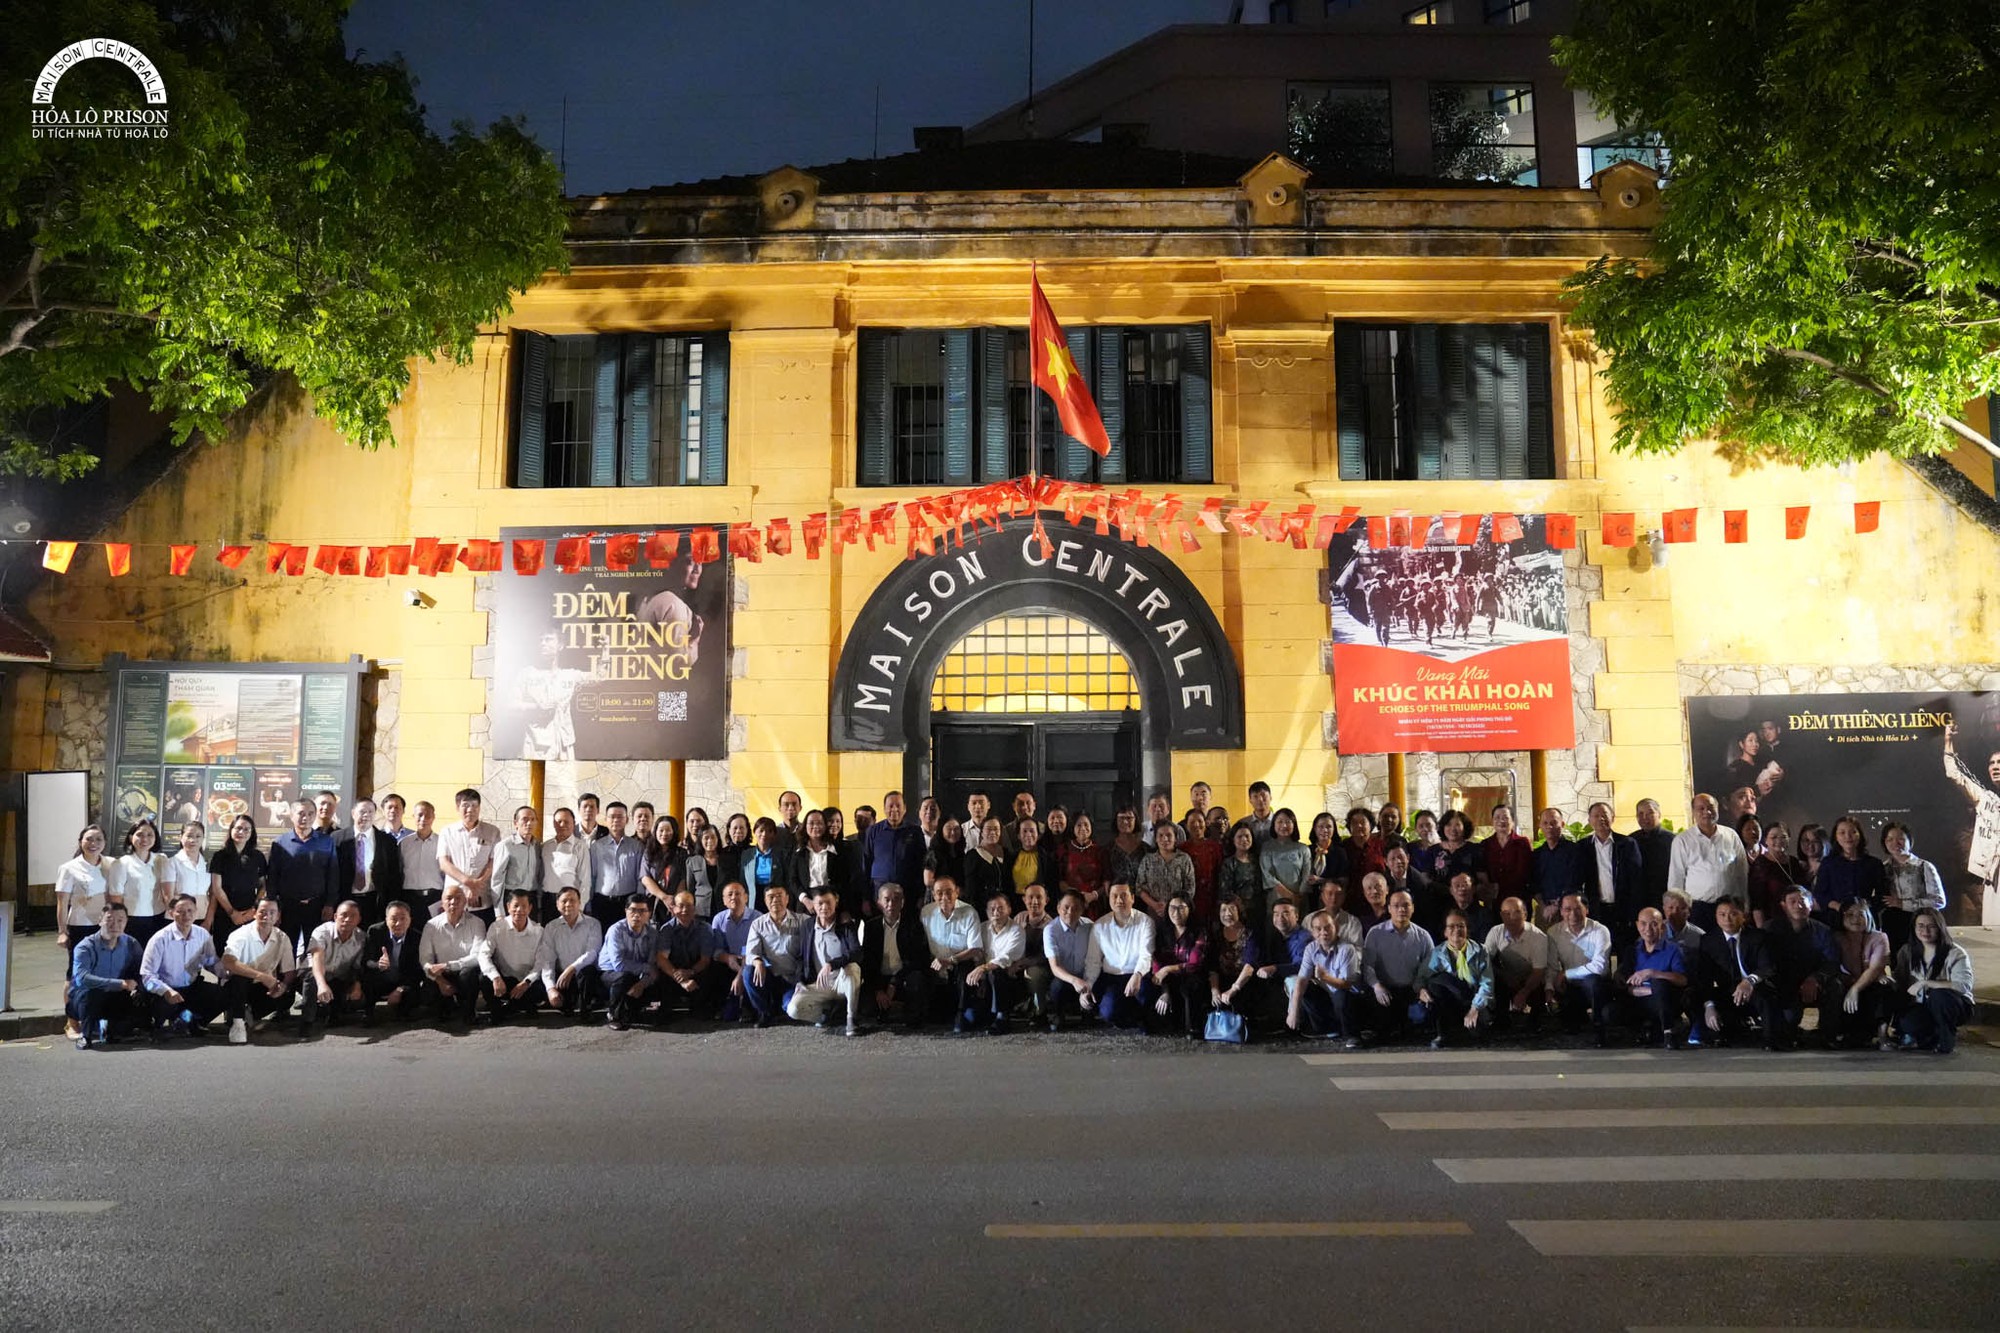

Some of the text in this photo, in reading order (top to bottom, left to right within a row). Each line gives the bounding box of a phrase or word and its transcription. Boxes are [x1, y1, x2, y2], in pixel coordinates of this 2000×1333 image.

[552, 583, 631, 618] ĐÊM
[562, 614, 691, 649] THIÊNG
[854, 534, 1213, 713] MAISON CENTRALE
[587, 645, 692, 681] LIÊNG
[1416, 665, 1490, 685] Vang Mãi
[1353, 680, 1554, 703] KHÚC KHẢI HOÀN
[1379, 702, 1530, 714] ECHOES OF THE TRIUMPHAL SONG
[1789, 708, 1953, 730] ĐÊM THIÊNG LIÊNG
[213, 782, 226, 791] 03
